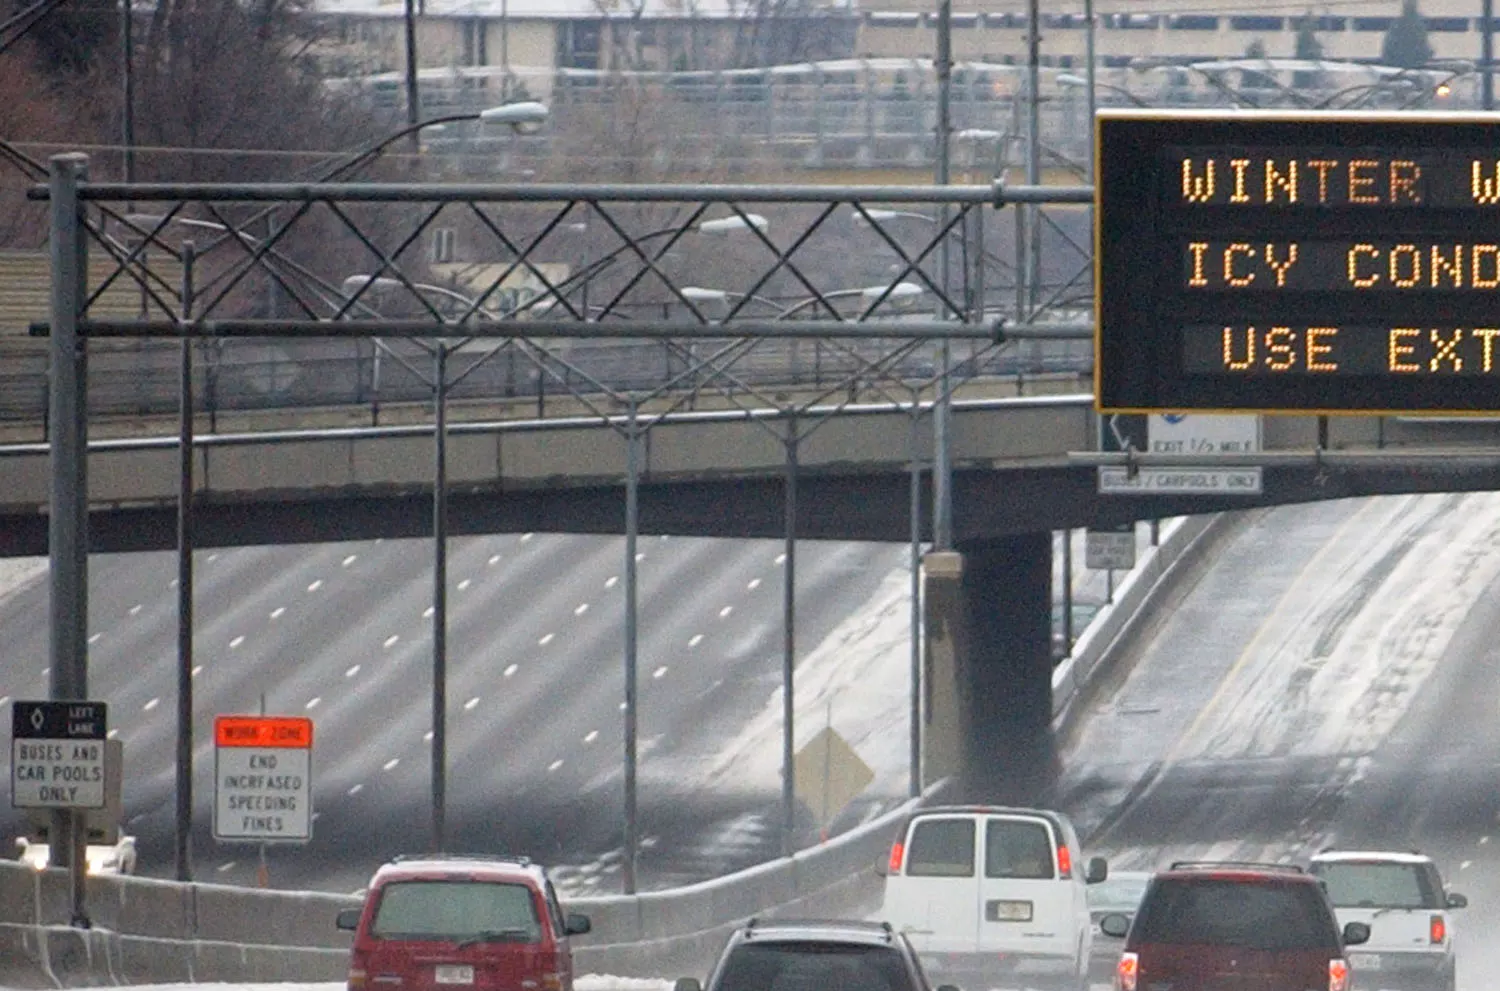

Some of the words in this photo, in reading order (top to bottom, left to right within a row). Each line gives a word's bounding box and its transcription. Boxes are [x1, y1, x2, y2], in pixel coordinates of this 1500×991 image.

[1182, 158, 1422, 204] WINTER
[1188, 243, 1299, 287] ICY
[1222, 327, 1339, 372] USE
[20, 744, 62, 761] BUSES
[72, 745, 98, 761] AND
[249, 754, 278, 770] END
[17, 765, 45, 781] CAR
[53, 766, 101, 782] POOLS
[224, 775, 302, 791] INCREASED
[39, 785, 78, 801] ONLY
[228, 795, 296, 811] SPEEDING
[242, 815, 282, 833] FINES
